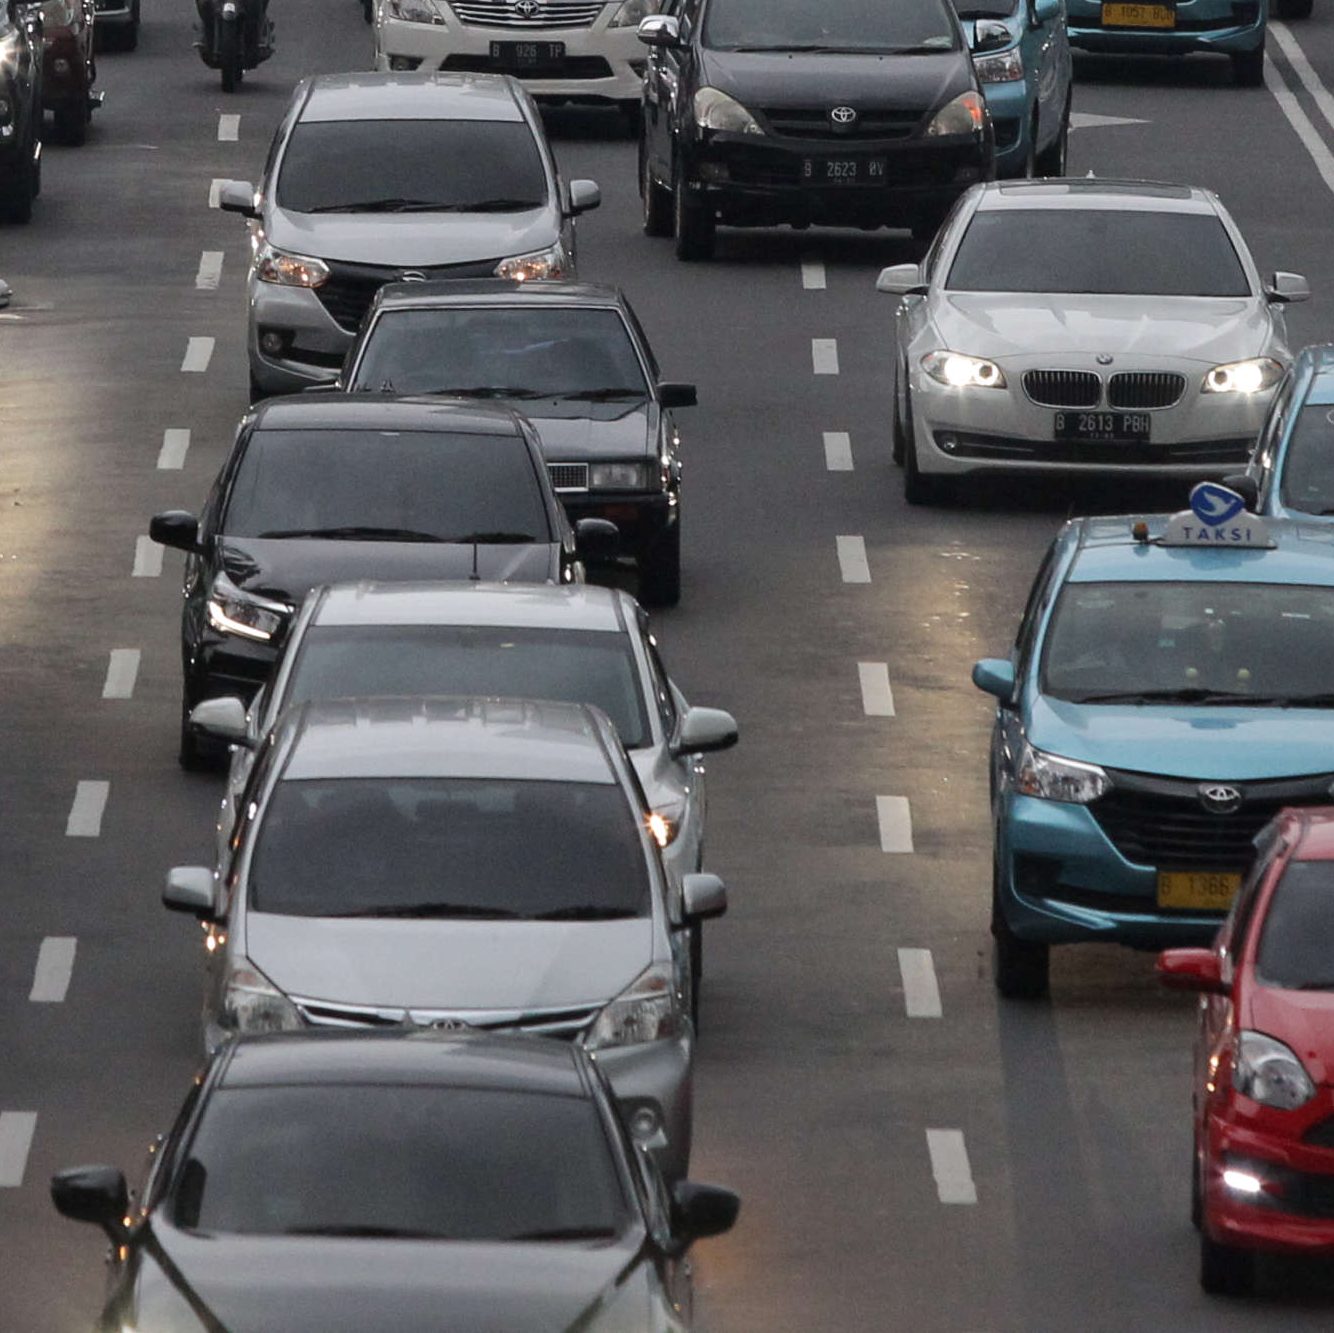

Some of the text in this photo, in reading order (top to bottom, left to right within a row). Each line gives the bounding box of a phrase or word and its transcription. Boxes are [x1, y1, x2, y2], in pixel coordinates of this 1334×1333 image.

[492, 44, 561, 59] B 926 TP
[826, 161, 858, 178] 2623
[1056, 414, 1151, 433] B 2613 PBH
[1182, 526, 1253, 541] TAKSI
